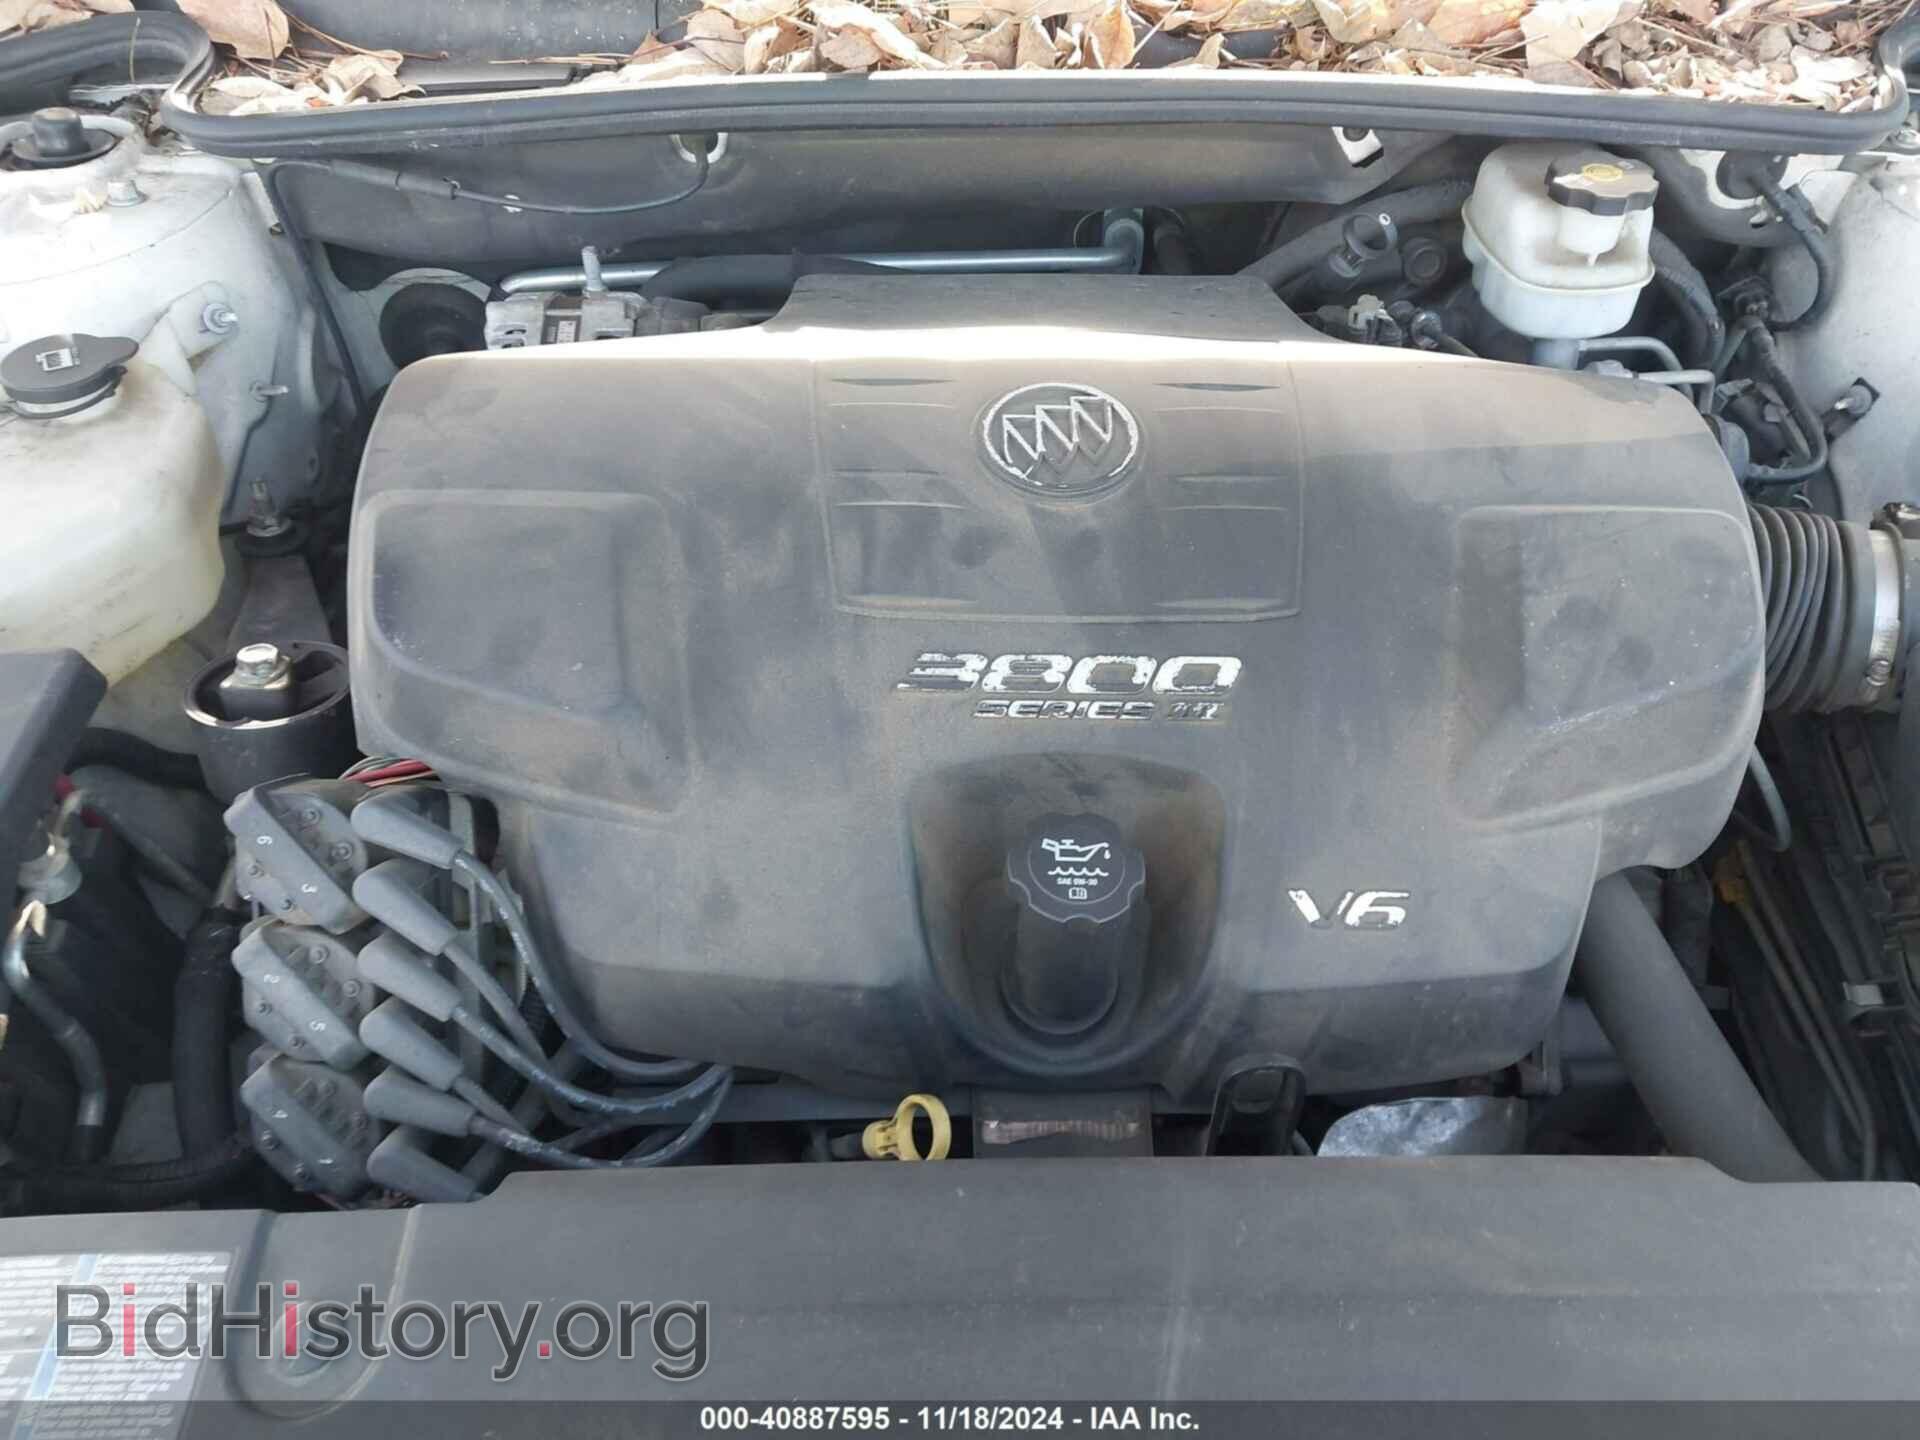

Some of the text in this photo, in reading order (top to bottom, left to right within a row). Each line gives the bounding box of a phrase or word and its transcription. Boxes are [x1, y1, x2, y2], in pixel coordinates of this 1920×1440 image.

[897, 652, 1243, 696] 3800
[973, 699, 1155, 721] SERIES
[256, 834, 273, 846] 6
[301, 883, 318, 894] 3
[1287, 888, 1410, 928] V6
[263, 973, 280, 984] 2
[309, 1020, 326, 1032] 5
